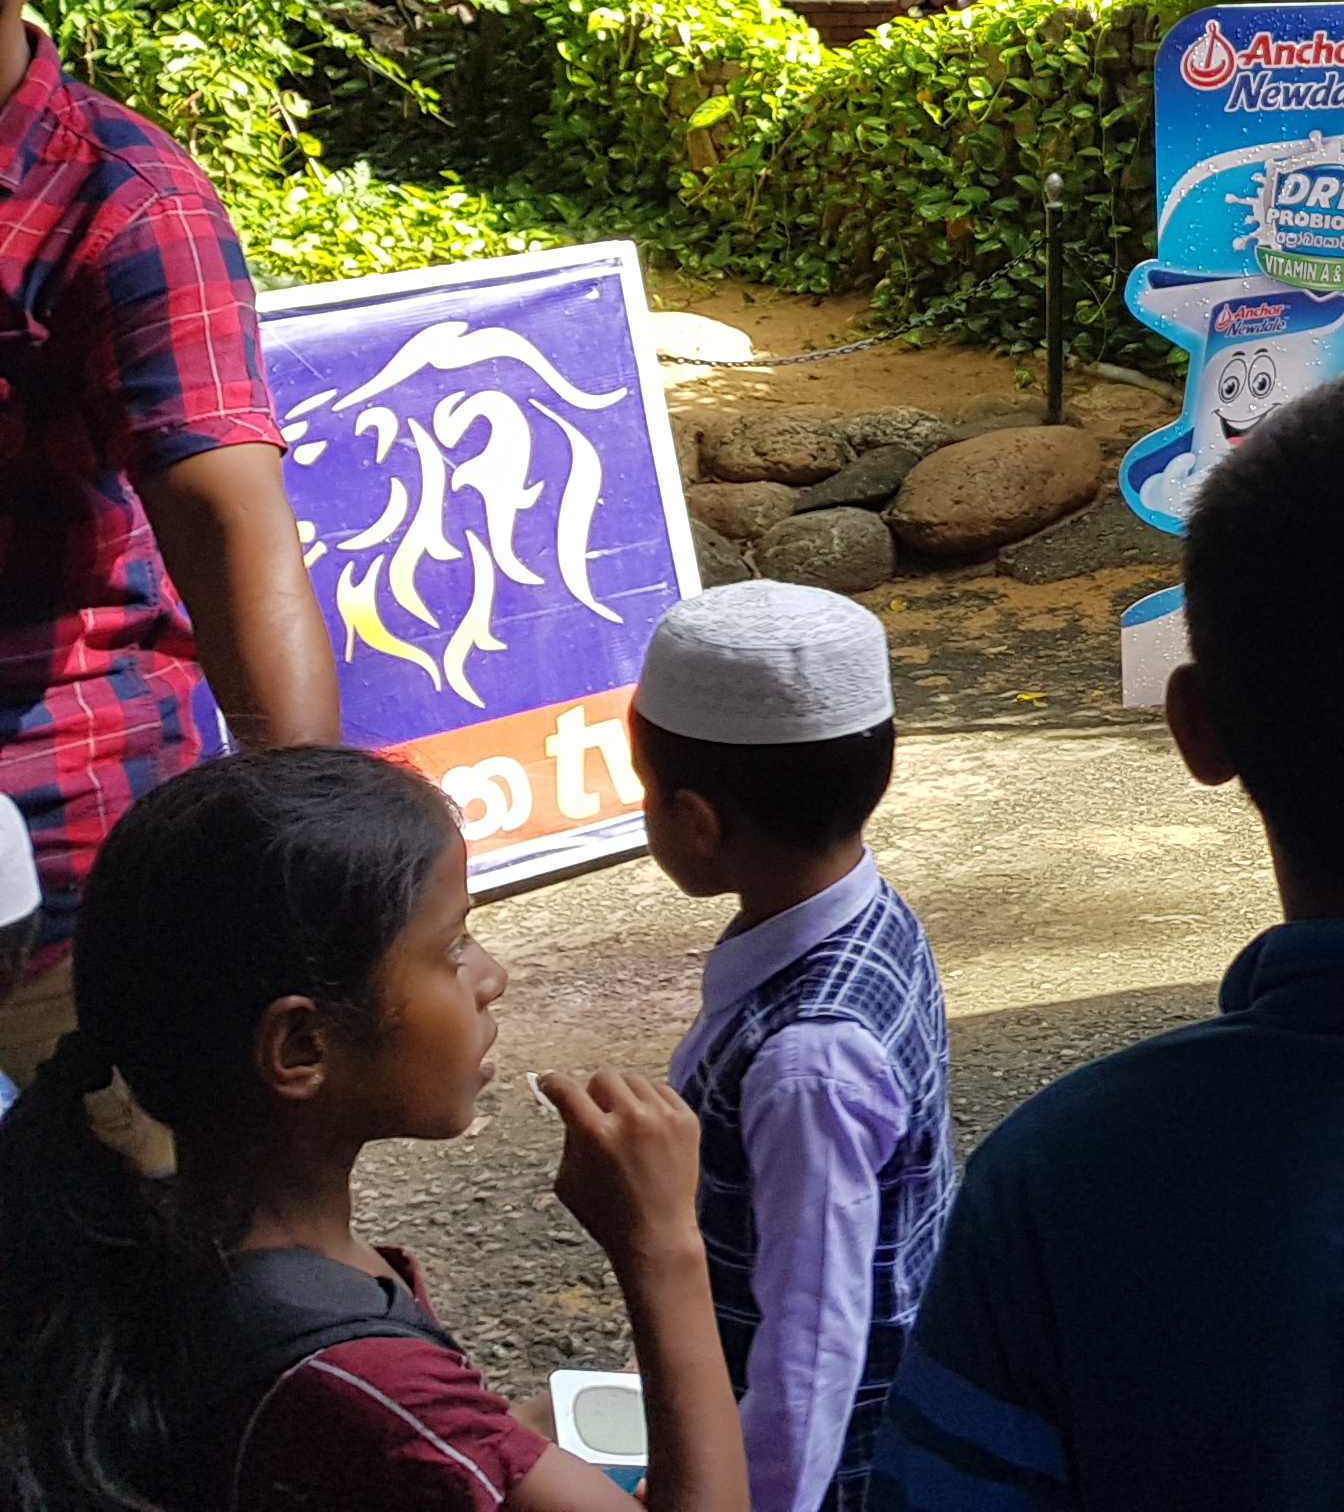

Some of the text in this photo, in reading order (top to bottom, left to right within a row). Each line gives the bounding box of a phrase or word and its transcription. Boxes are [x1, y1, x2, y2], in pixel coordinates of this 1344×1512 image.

[1265, 254, 1317, 280] VITAMIN
[1320, 266, 1330, 281] A
[1333, 265, 1341, 283] &
[1232, 303, 1285, 319] Anchor
[1224, 317, 1287, 338] Newdale
